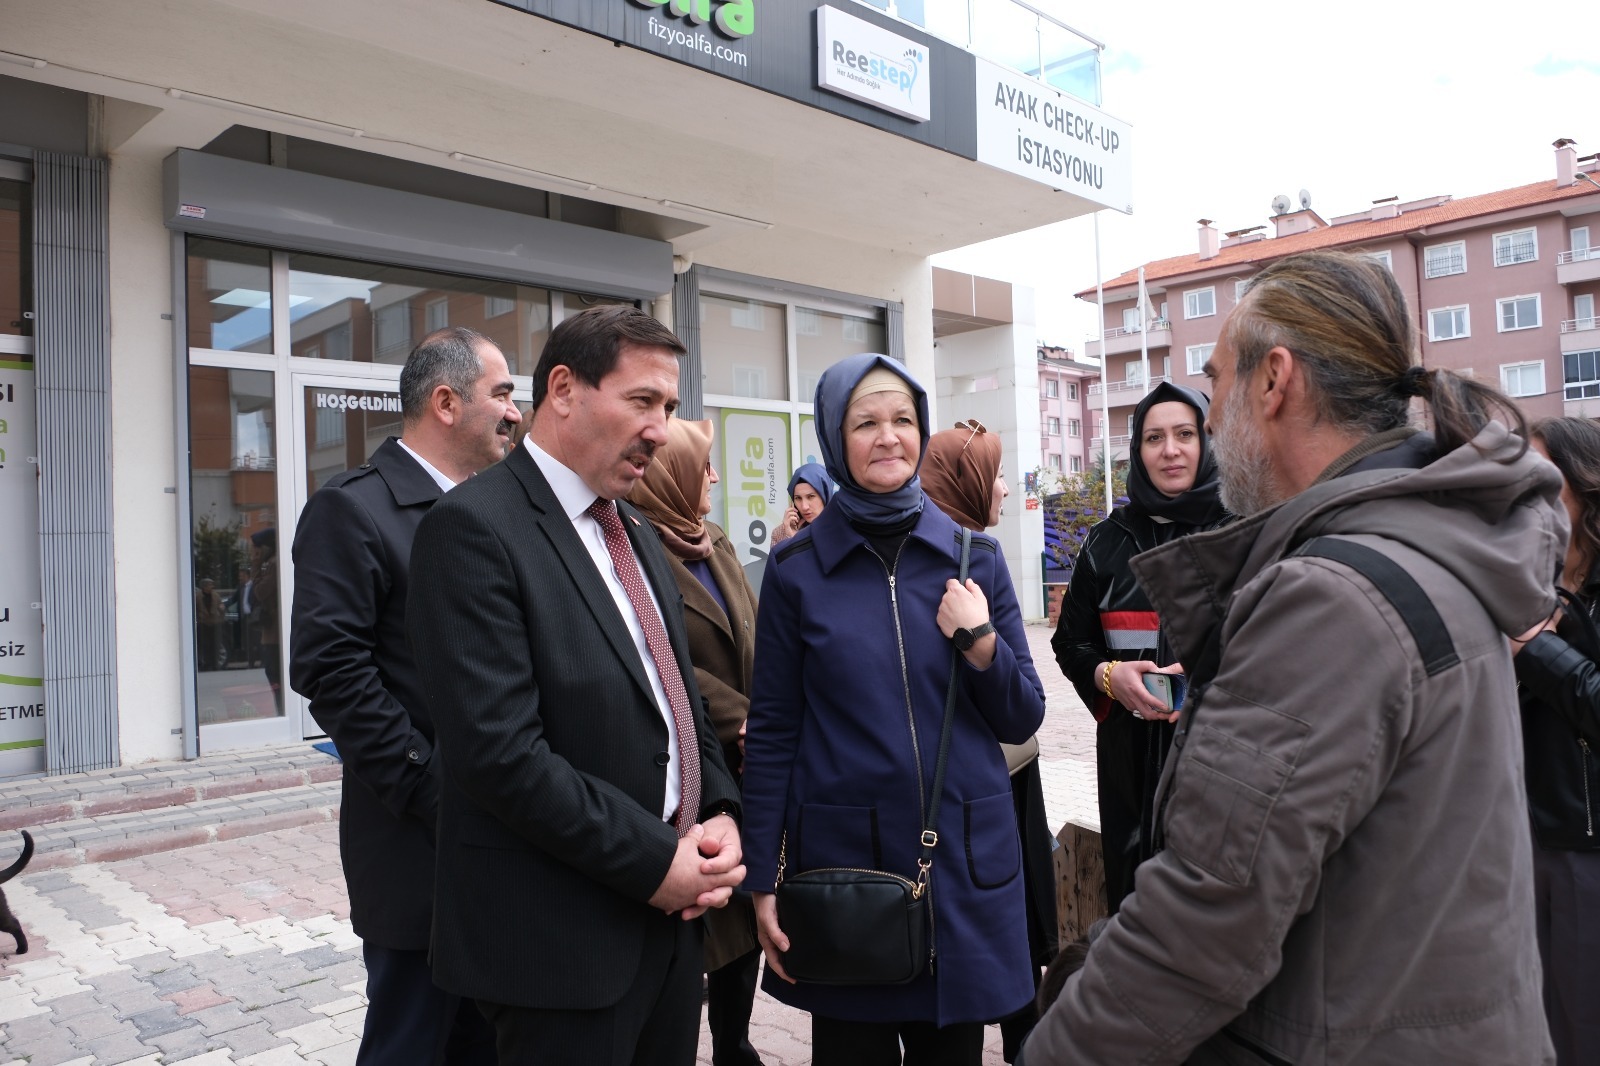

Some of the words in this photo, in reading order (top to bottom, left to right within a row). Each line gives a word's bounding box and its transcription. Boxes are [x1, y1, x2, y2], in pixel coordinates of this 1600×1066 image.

[648, 16, 747, 67] fizyoalfa.com
[832, 40, 911, 92] Reestep
[995, 81, 1038, 123] AYAK
[1043, 101, 1119, 154] CHECK-UP
[1017, 127, 1103, 190] İSTASYONU
[768, 437, 777, 505] fizyoalfa.com
